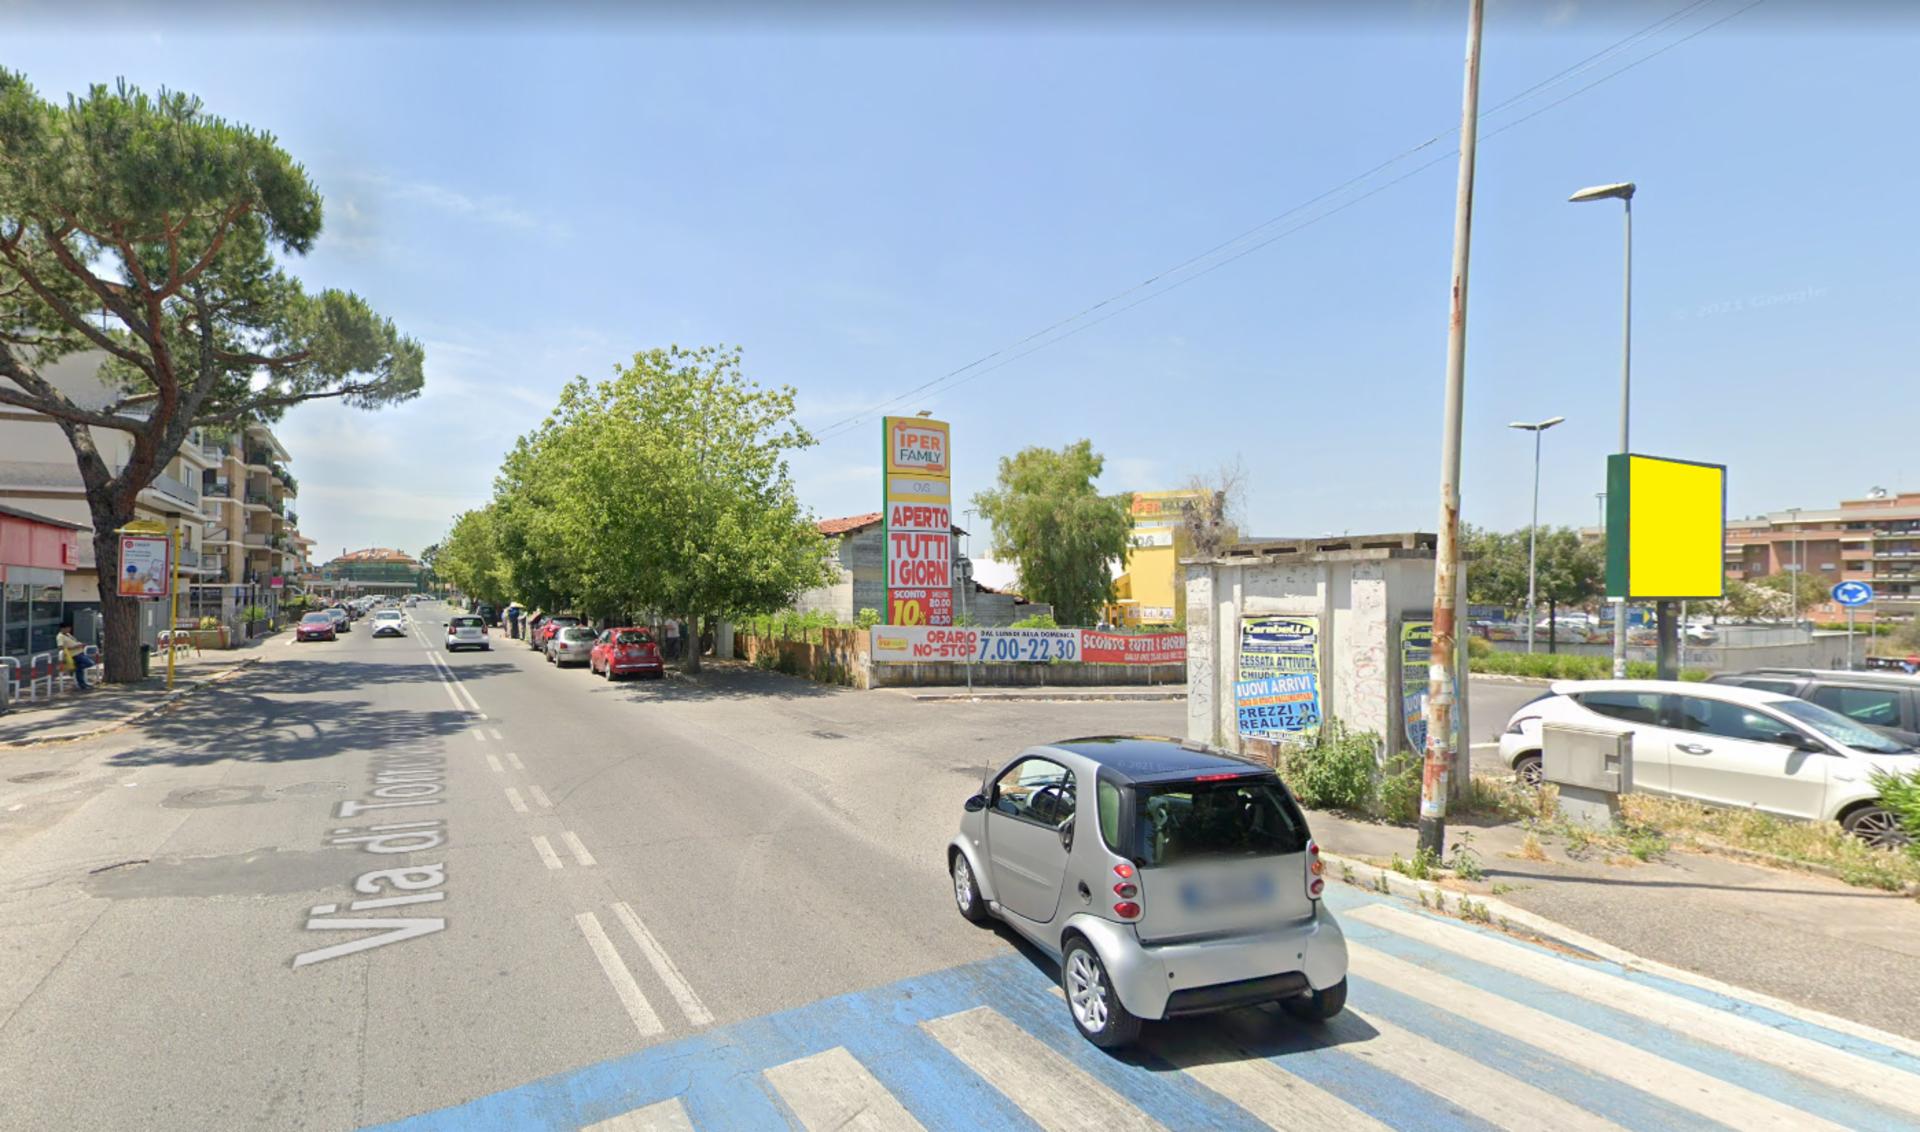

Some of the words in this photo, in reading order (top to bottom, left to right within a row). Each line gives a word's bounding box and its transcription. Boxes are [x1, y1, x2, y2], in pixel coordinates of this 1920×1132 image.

[900, 433, 941, 450] IPER
[891, 505, 949, 528] APERTO
[891, 533, 948, 560] TUTTI
[893, 590, 926, 599] SCONTO
[927, 630, 976, 644] ORARIO
[913, 643, 976, 657] NO-STOP
[1240, 655, 1274, 667] CESSATA
[1271, 676, 1311, 694] ARRIVI
[1239, 704, 1293, 719] PREZZI
